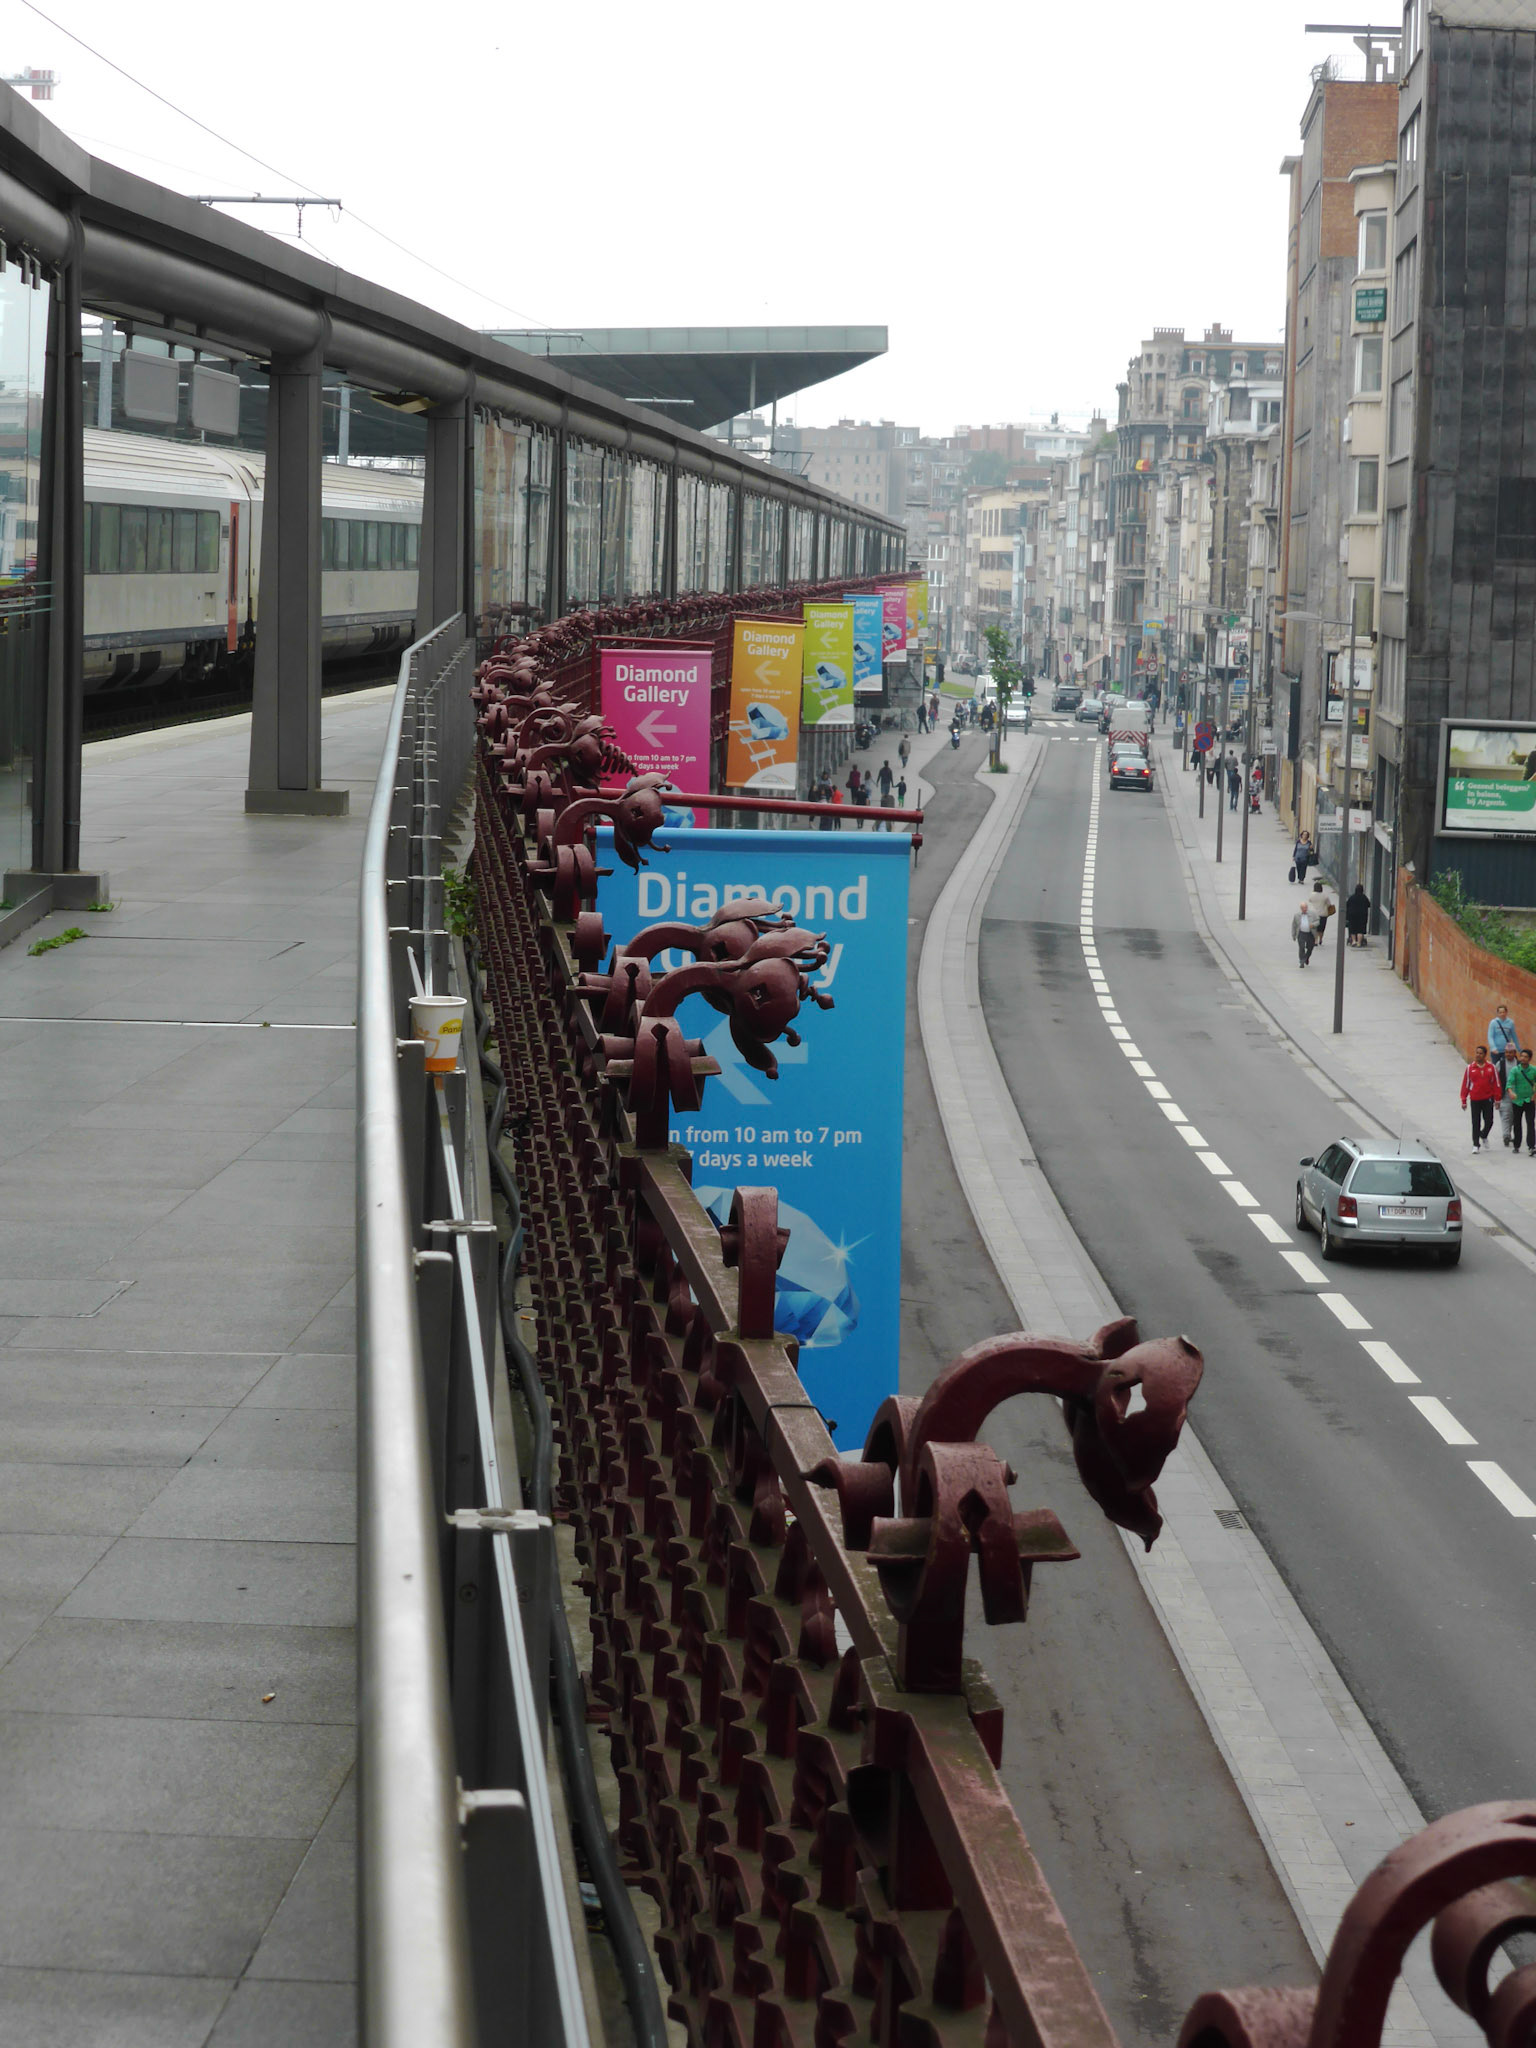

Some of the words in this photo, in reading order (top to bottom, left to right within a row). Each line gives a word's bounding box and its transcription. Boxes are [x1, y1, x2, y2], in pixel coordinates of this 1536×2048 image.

[810, 610, 848, 619] Diamond
[814, 619, 844, 630] Gallery
[743, 630, 796, 645] Diamond
[747, 643, 789, 659] Gallery
[616, 665, 698, 682] Diamond
[624, 685, 689, 706] Gallery
[686, 1126, 729, 1143] from
[735, 1127, 756, 1143] 10
[761, 1130, 789, 1143] am
[794, 1128, 813, 1143] to
[818, 1127, 829, 1143] 7
[834, 1130, 862, 1147] pm
[699, 1150, 741, 1170] days
[747, 1153, 758, 1167] a
[763, 1150, 813, 1167] week
